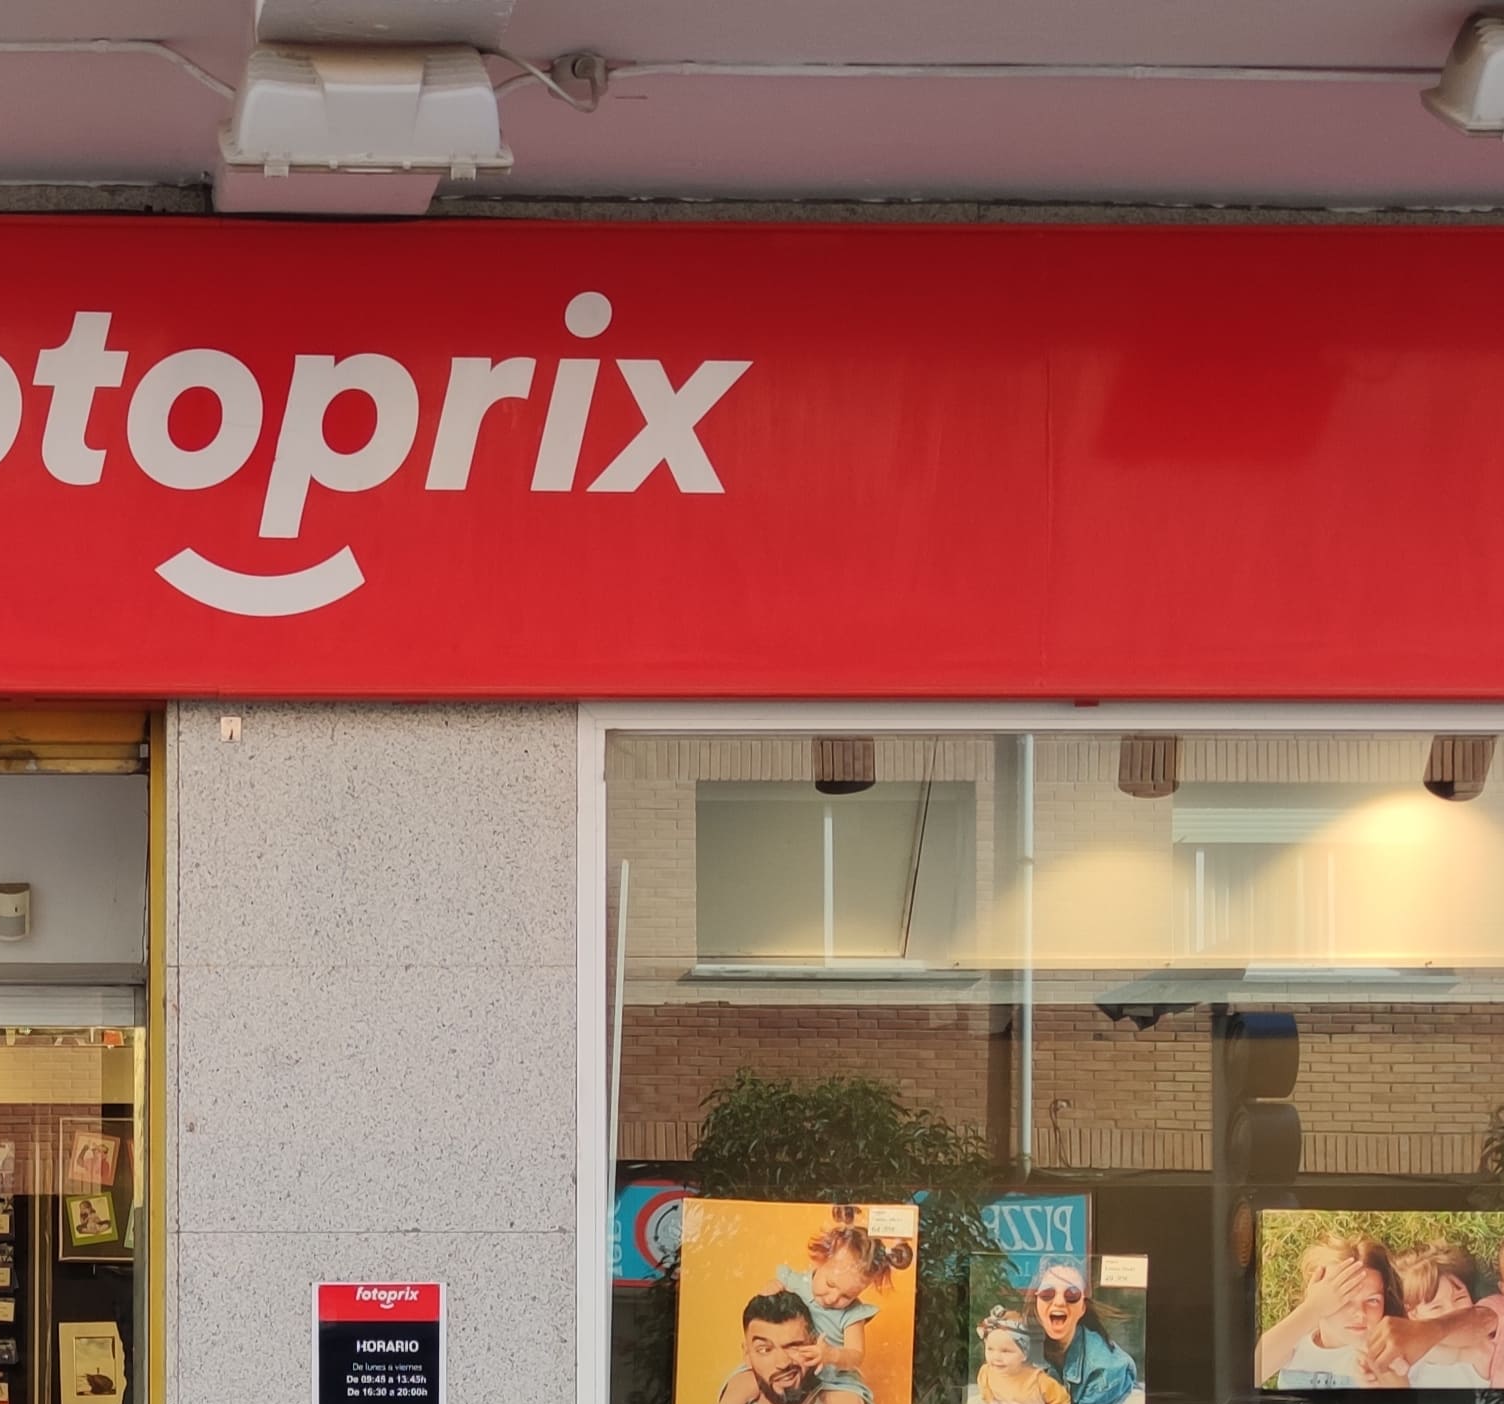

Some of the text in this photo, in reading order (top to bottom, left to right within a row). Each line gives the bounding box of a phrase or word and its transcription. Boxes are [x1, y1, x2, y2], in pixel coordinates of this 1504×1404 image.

[355, 1286, 419, 1303] fotoprix
[356, 1339, 420, 1353] HORARIO
[352, 1362, 363, 1372] De
[365, 1362, 387, 1372] lunes
[394, 1363, 423, 1372] viernes
[346, 1375, 359, 1384] De
[347, 1387, 360, 1397] De
[363, 1387, 387, 1397] 16:30
